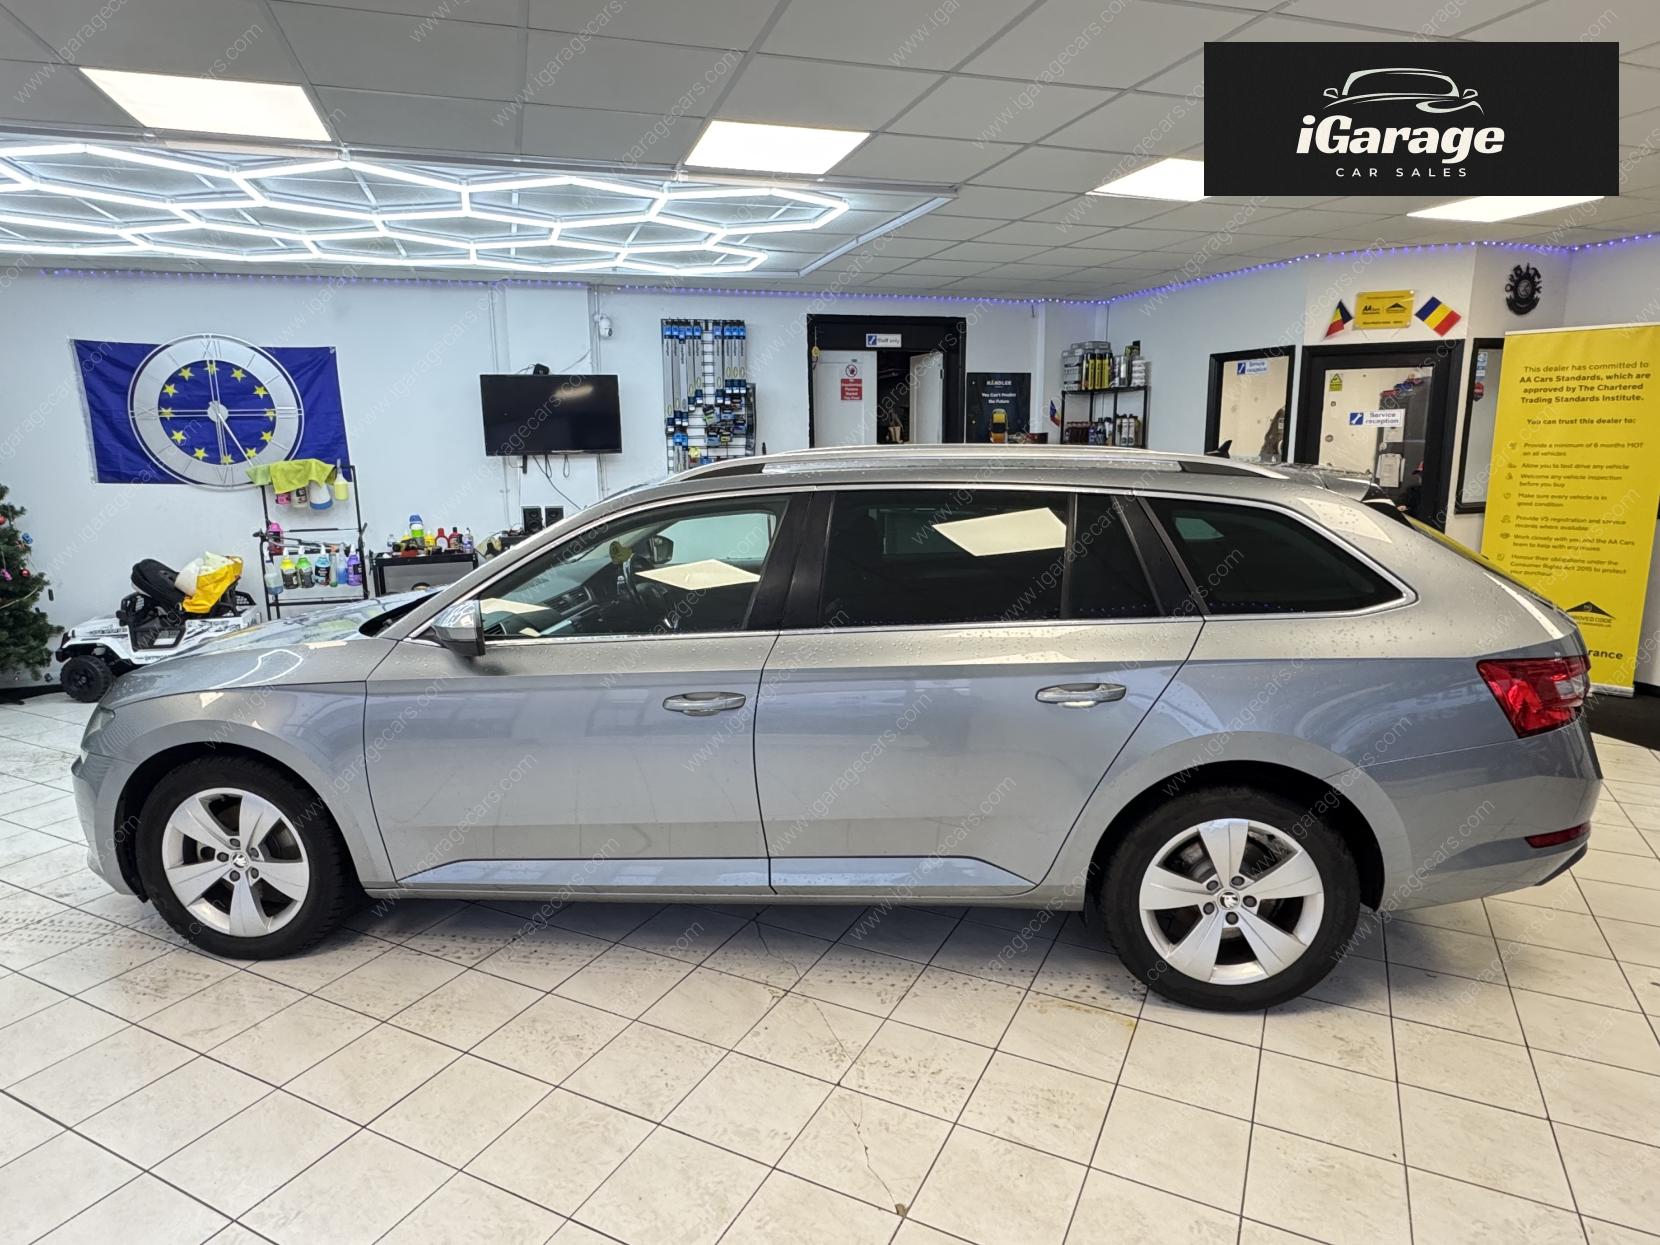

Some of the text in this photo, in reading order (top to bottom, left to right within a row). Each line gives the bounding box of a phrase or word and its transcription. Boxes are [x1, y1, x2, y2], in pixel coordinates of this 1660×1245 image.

[1588, 361, 1637, 370] committed
[1555, 374, 1604, 382] Standards,
[1597, 383, 1643, 391] Chartered
[1554, 395, 1600, 403] Standards
